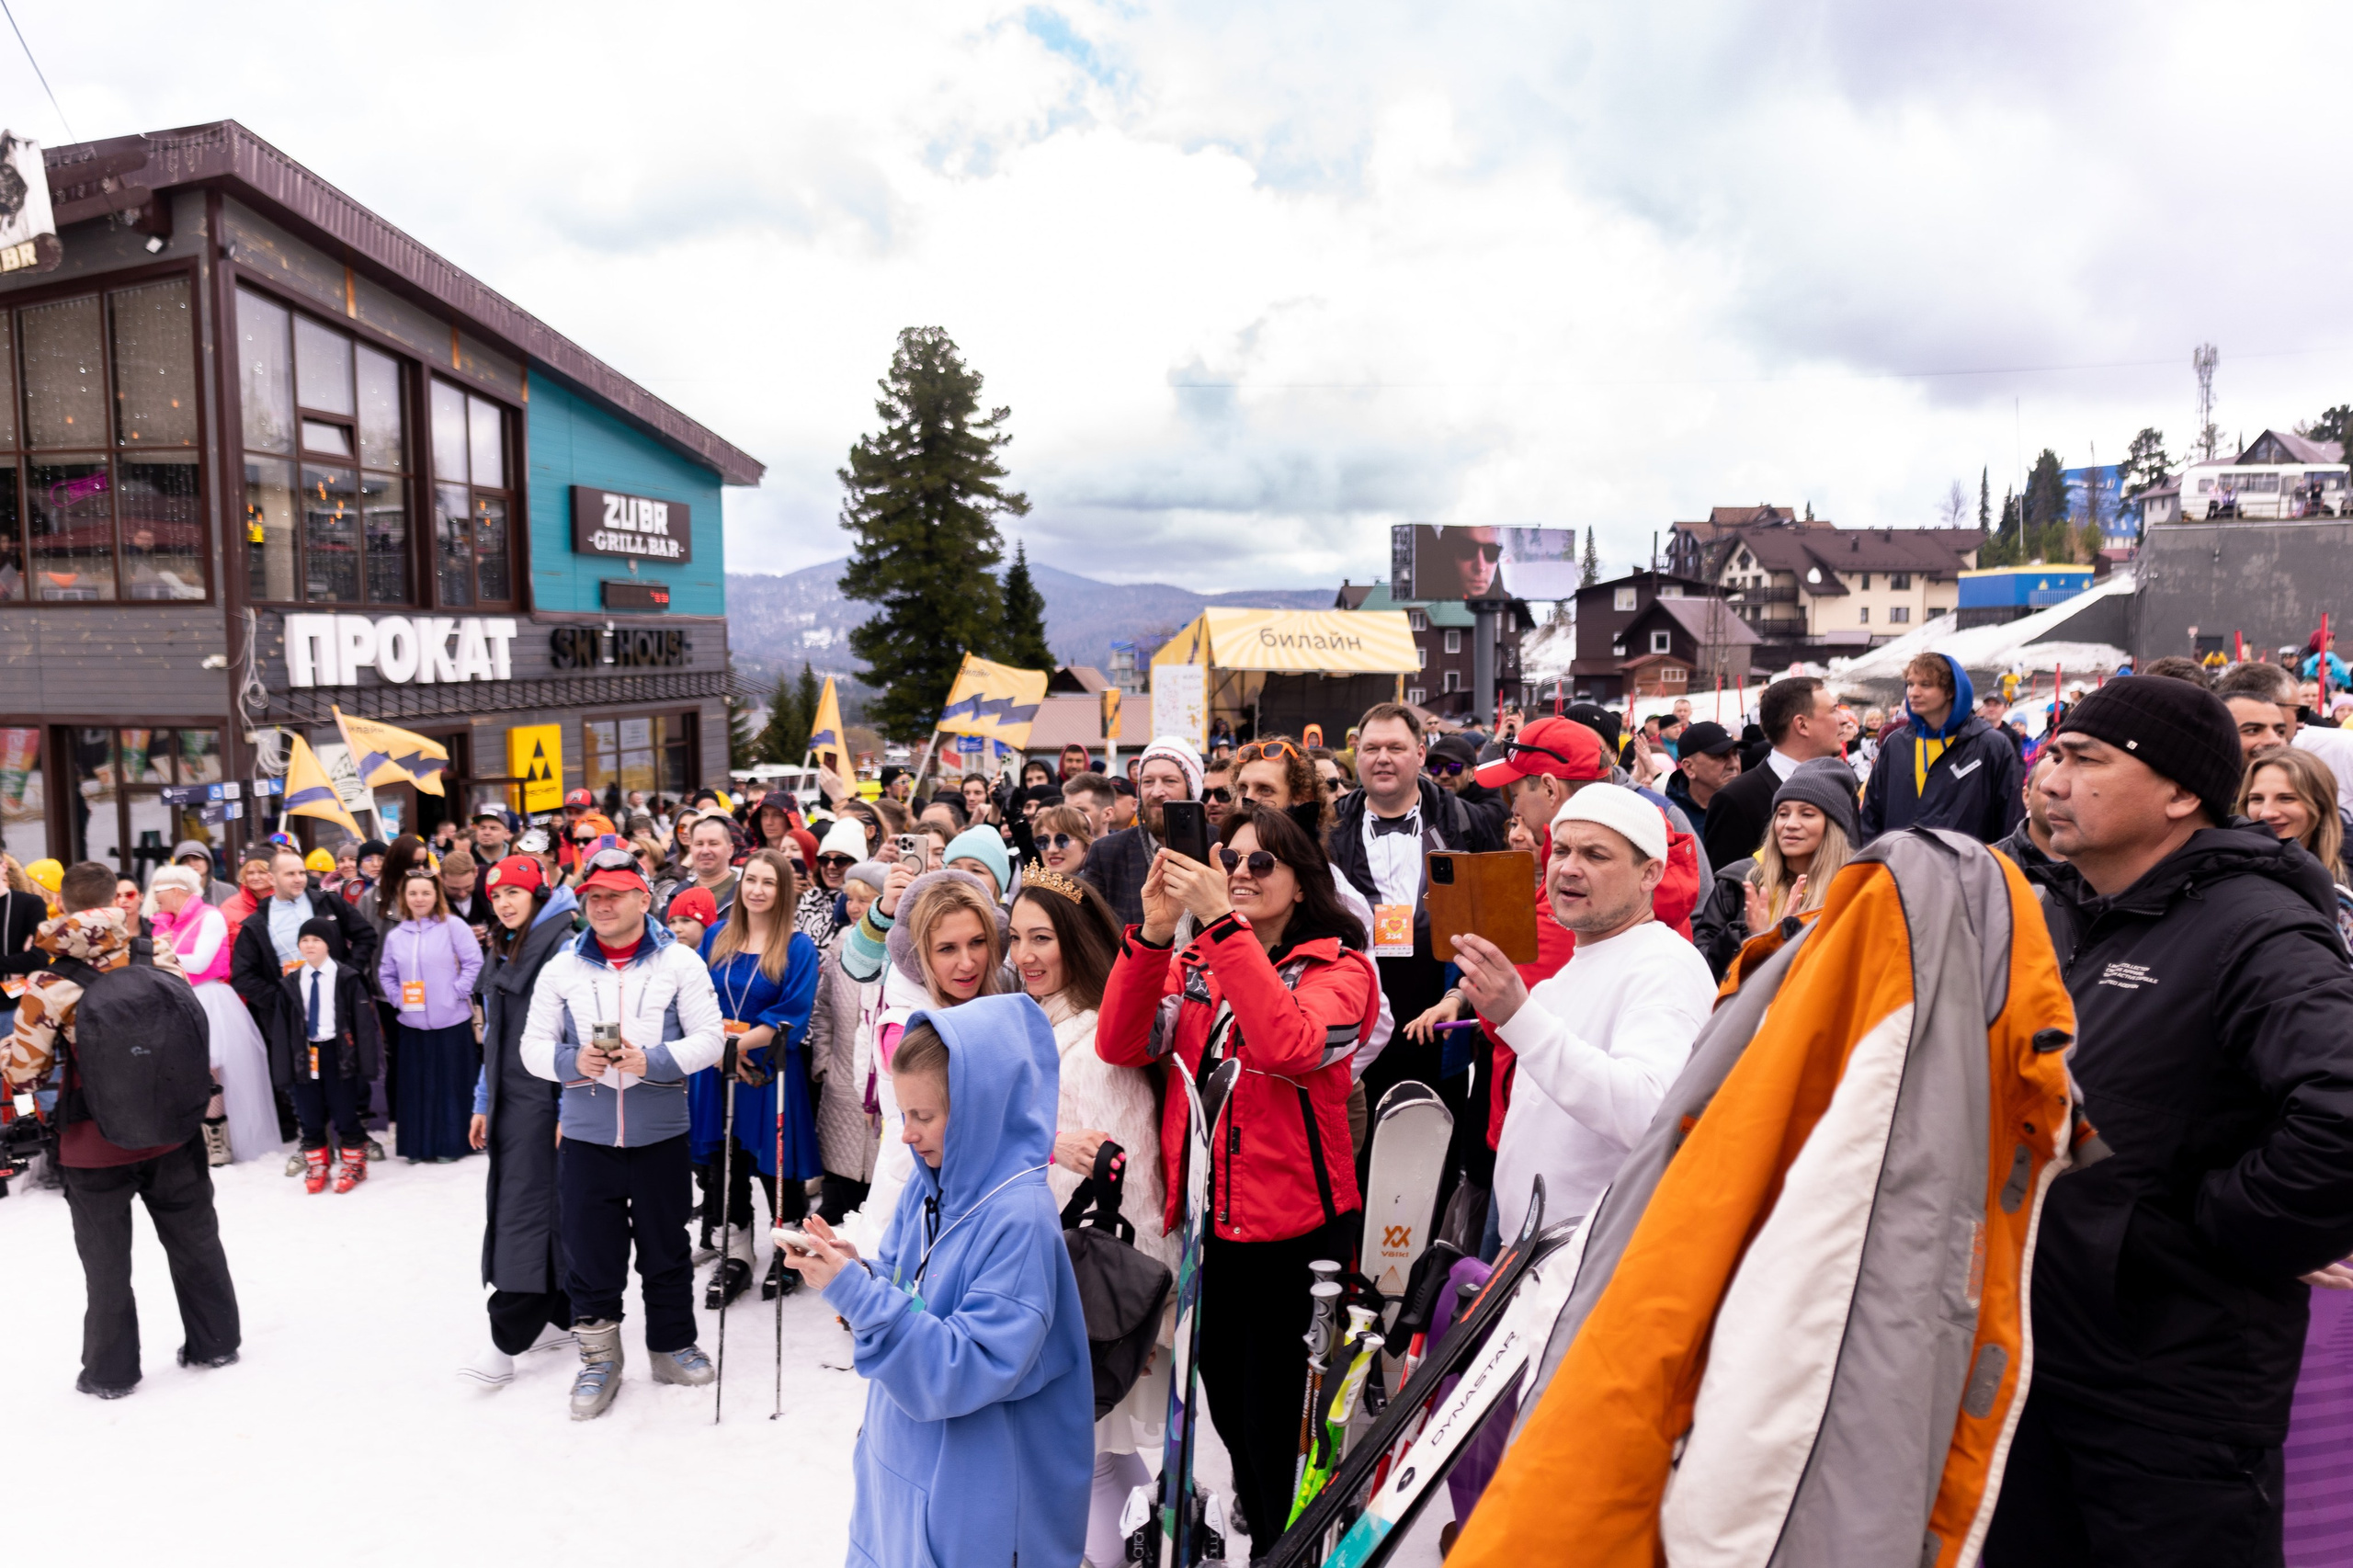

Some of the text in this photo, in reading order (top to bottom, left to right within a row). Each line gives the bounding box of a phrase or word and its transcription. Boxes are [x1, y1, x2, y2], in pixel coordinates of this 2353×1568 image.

[0, 242, 38, 273] BR
[602, 493, 669, 535] ZUBR
[284, 612, 517, 687] ПРОКАТ
[615, 630, 693, 667] HOUSE
[1259, 628, 1362, 651] билайн
[346, 724, 385, 735] илайн
[522, 787, 558, 798] ISCHER
[1431, 1331, 1517, 1447] DYNASTAR
